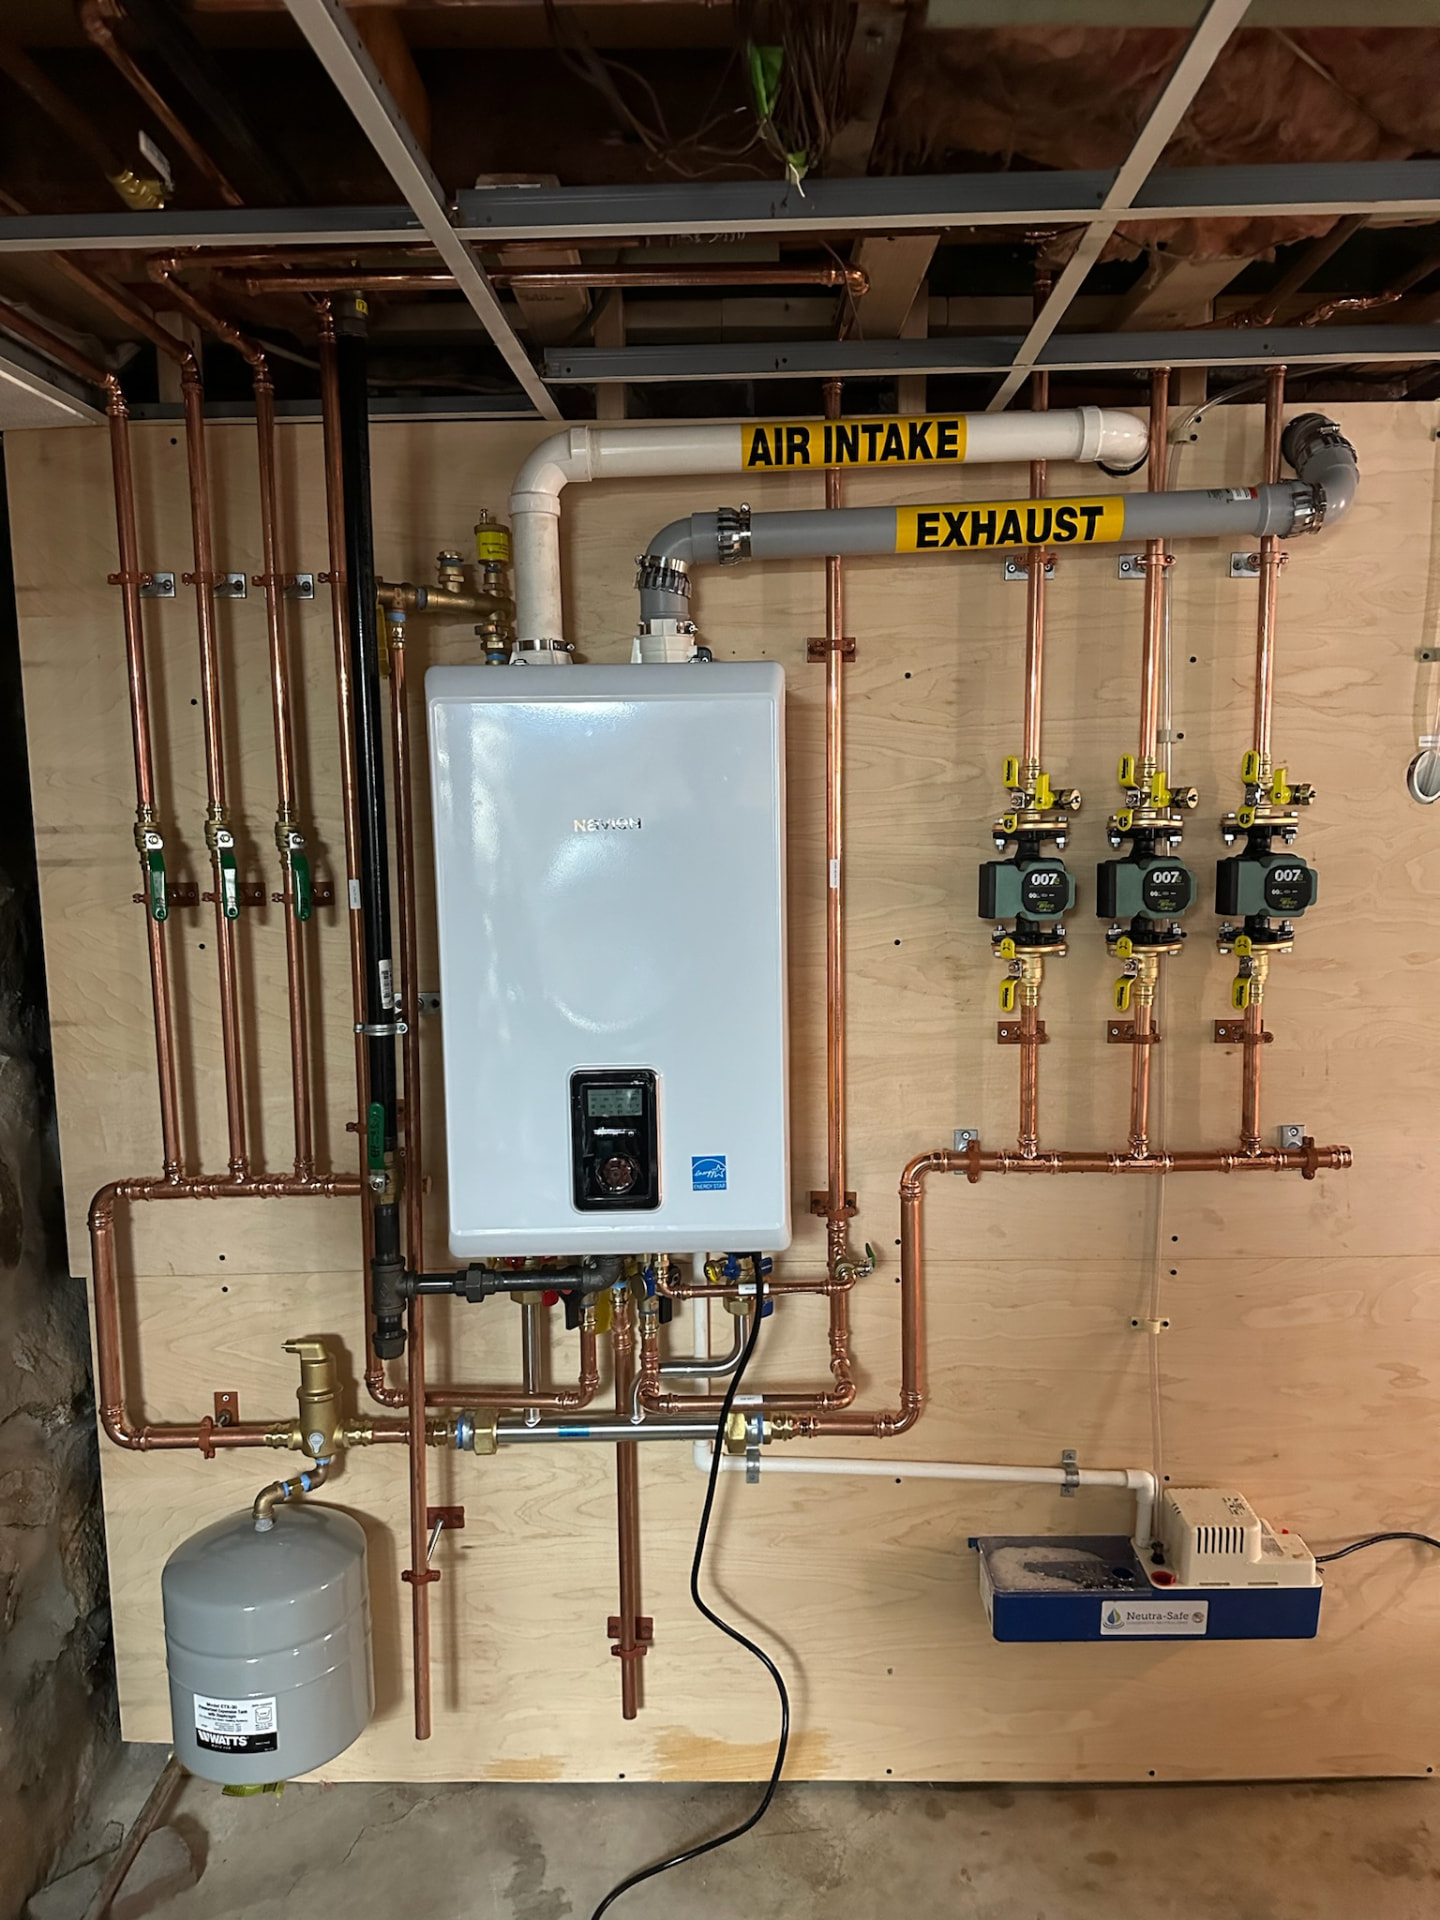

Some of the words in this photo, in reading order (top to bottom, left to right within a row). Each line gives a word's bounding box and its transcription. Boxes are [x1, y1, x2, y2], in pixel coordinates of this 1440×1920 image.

[748, 426, 811, 466] AIR
[824, 420, 960, 463] INTAKE
[916, 506, 1104, 548] EXHAUST
[1126, 1611, 1189, 1621] Neutra-Safe
[209, 1733, 247, 1746] WATTS
